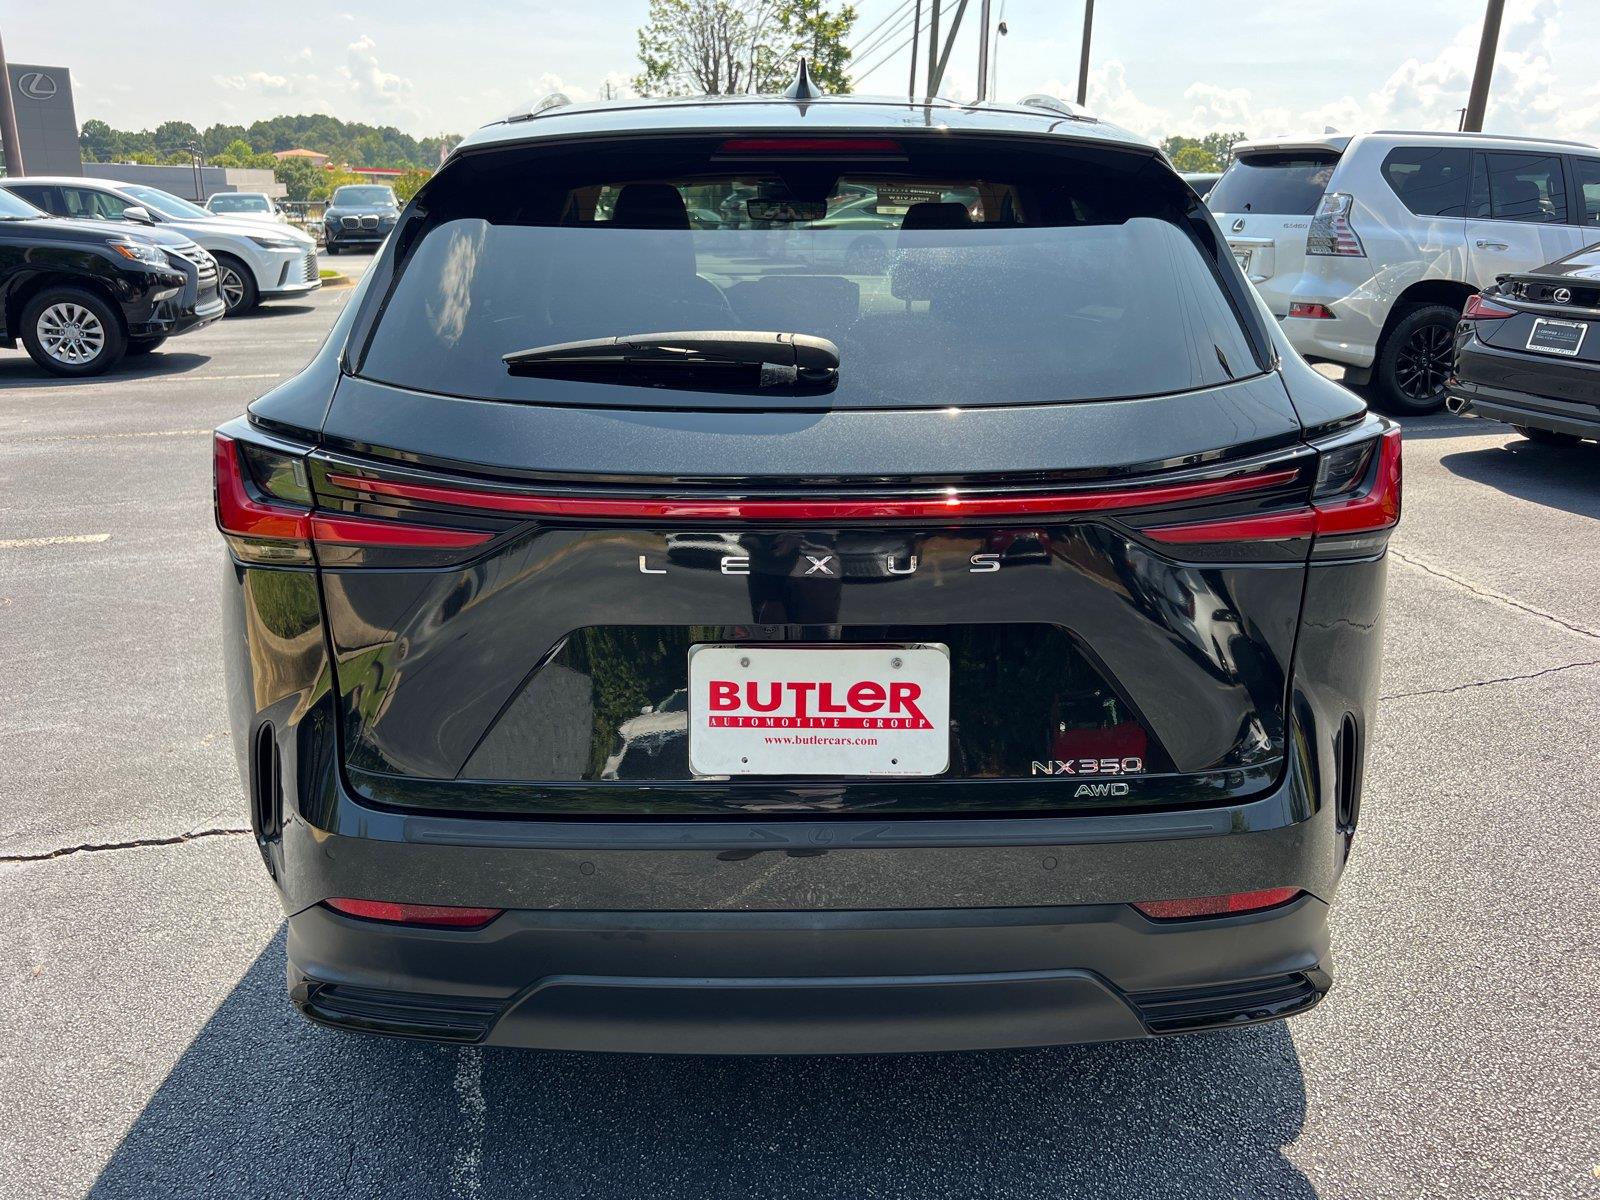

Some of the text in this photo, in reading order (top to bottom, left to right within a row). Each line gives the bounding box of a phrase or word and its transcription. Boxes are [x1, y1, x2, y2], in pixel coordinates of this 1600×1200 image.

[639, 554, 1001, 575] LEXUS
[710, 717, 926, 728] AUTOMOTIVE GROUP
[764, 735, 878, 746] www.butlercars.com
[1031, 757, 1142, 775] NX350
[1074, 782, 1129, 797] AWD
